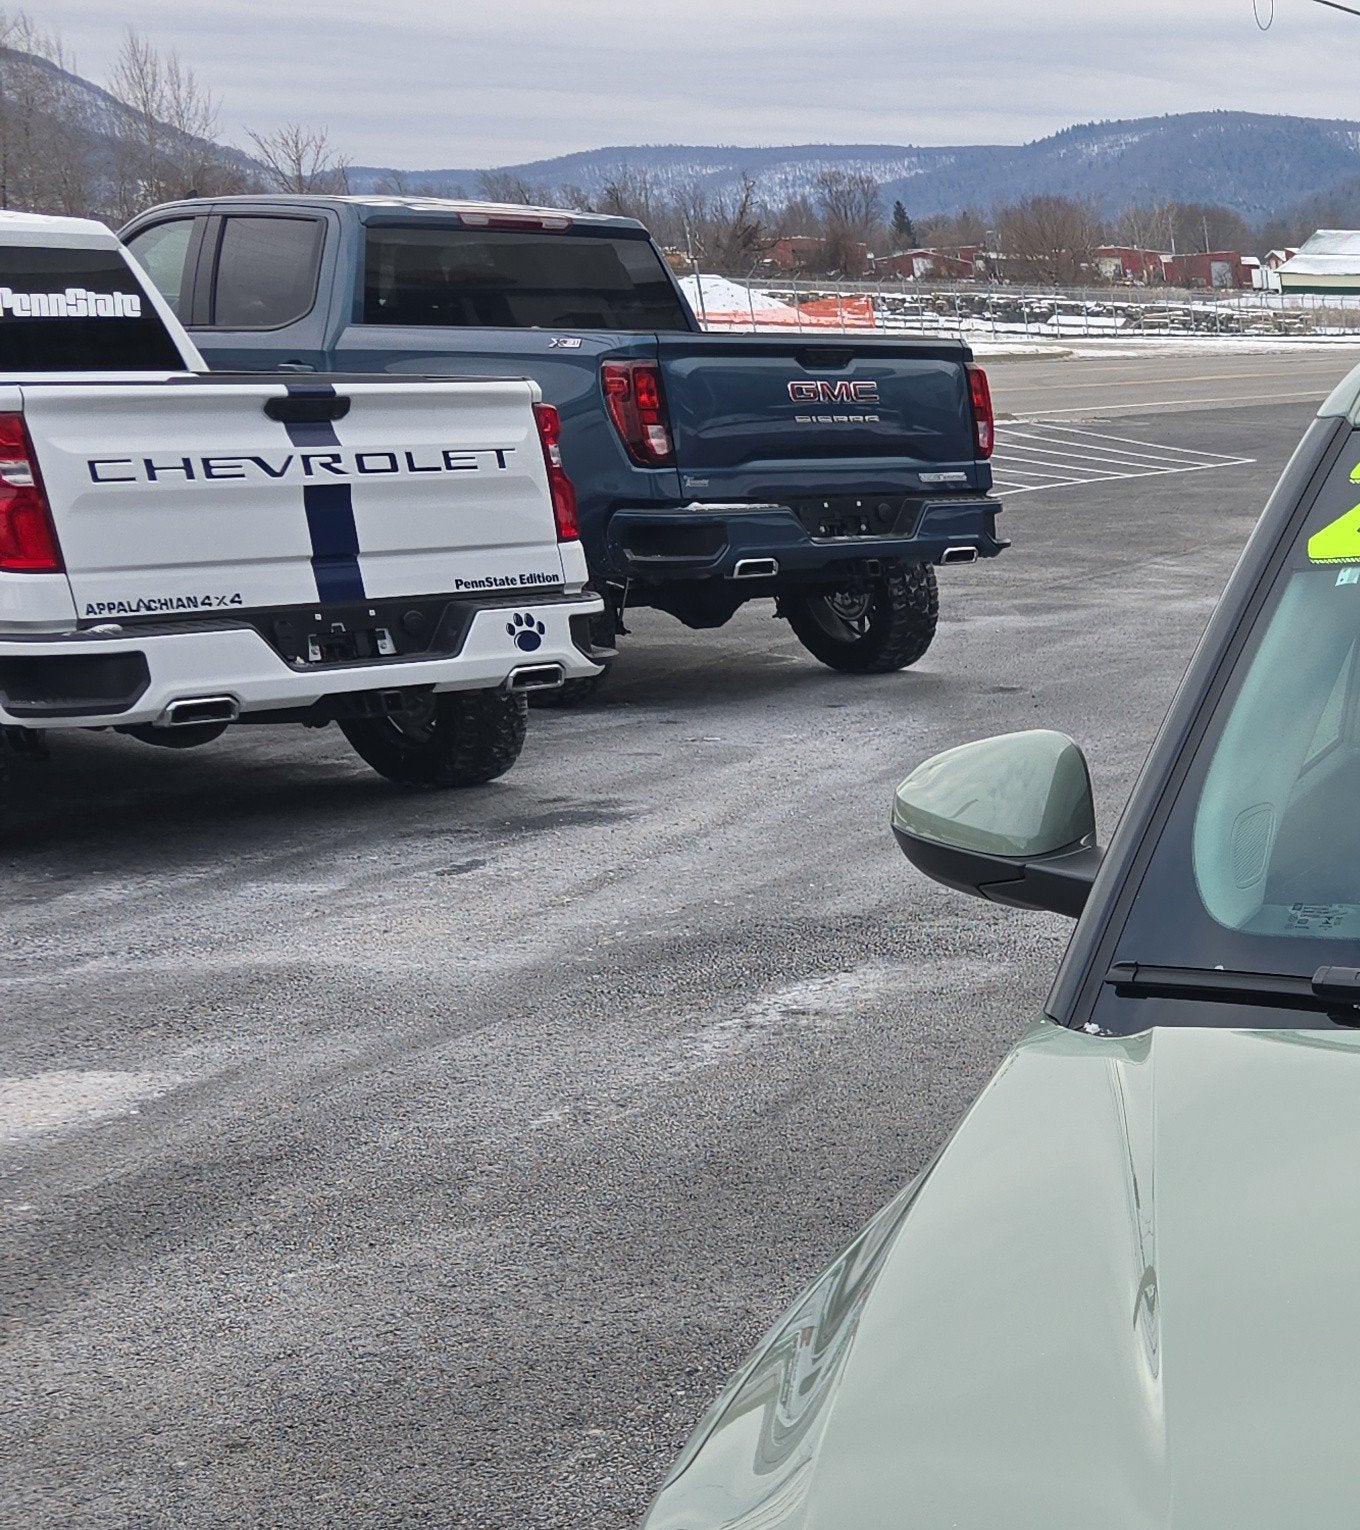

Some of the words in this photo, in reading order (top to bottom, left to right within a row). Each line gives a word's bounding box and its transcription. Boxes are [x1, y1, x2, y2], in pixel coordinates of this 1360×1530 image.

[787, 380, 880, 403] GMC
[86, 447, 516, 483] CHEVROLET
[454, 576, 519, 590] PennState
[519, 572, 560, 585] Edition
[85, 596, 199, 616] APPALACHIAN
